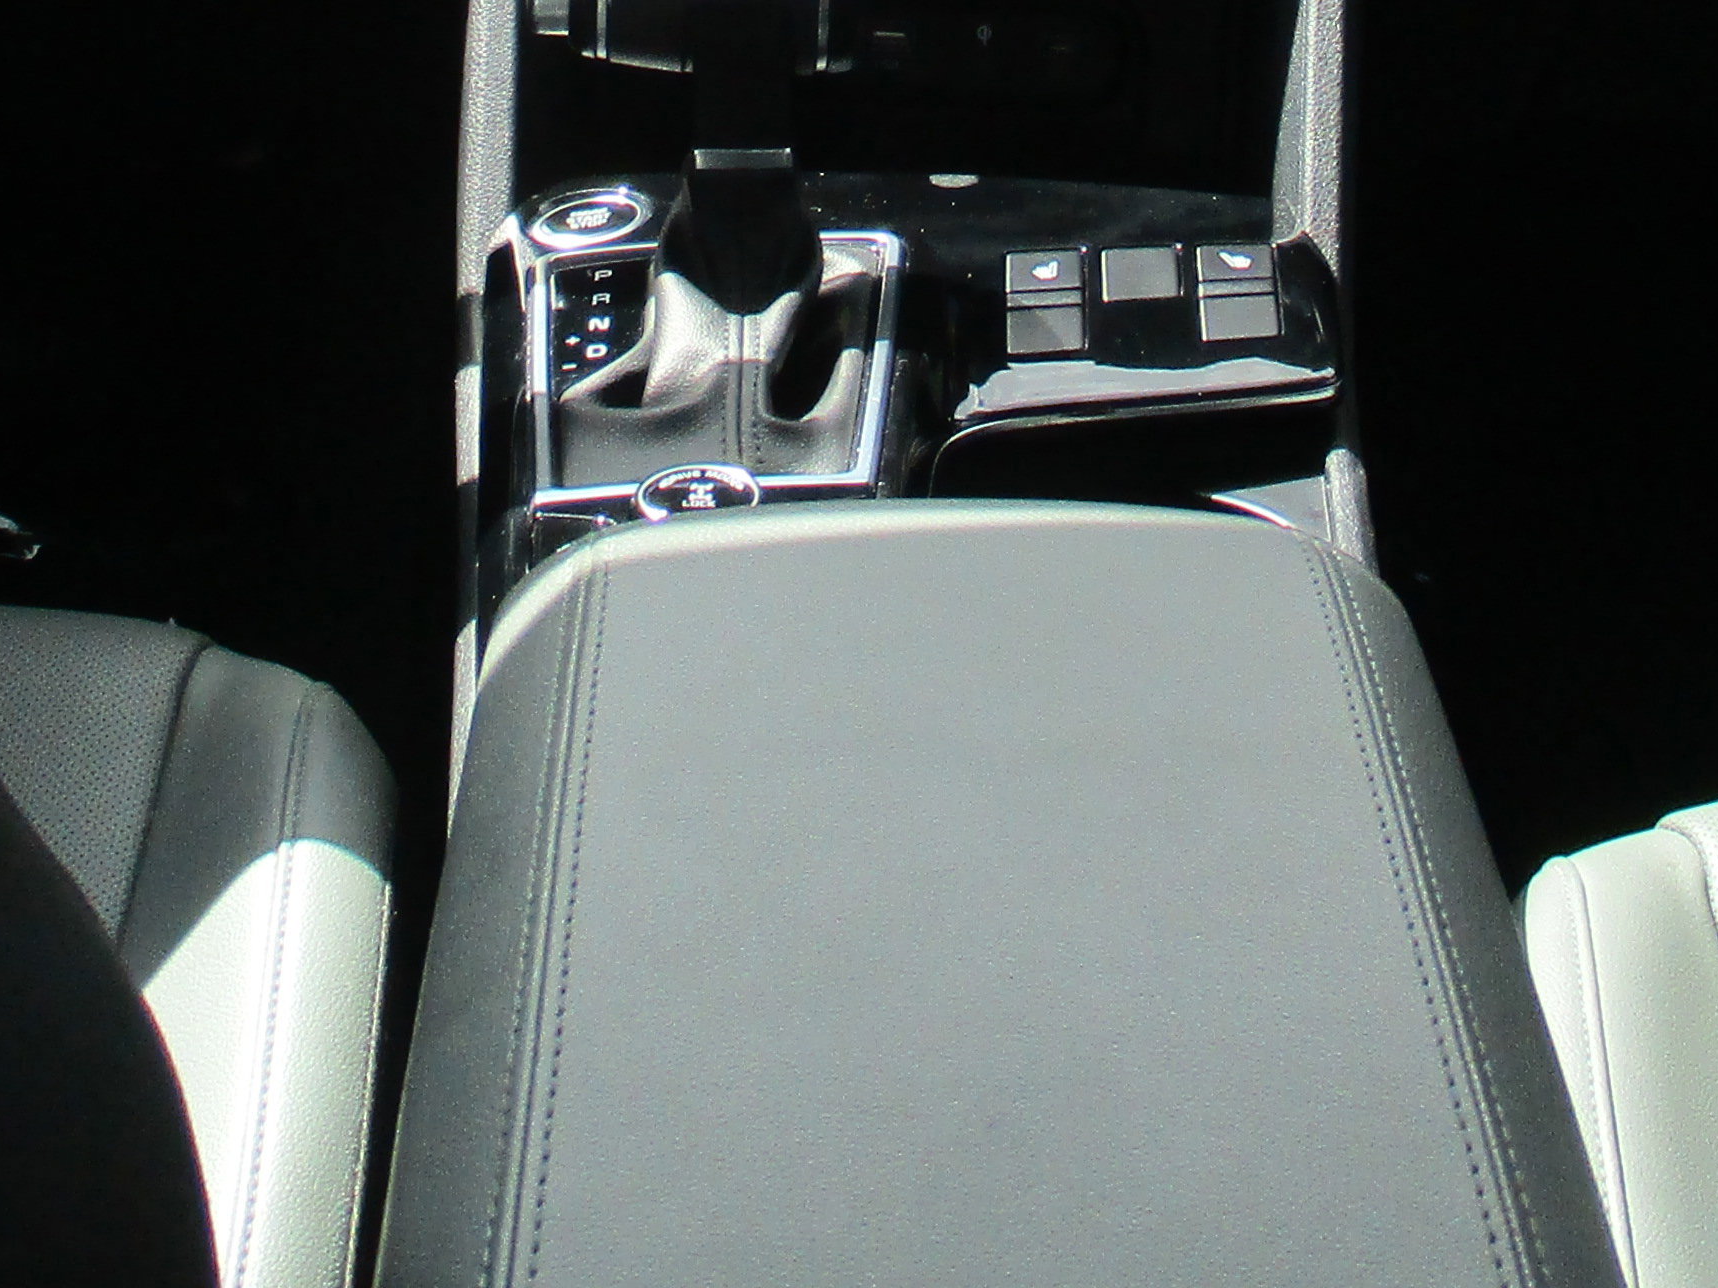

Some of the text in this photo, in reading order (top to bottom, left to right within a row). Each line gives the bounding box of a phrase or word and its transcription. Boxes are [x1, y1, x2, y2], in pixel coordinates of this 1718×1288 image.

[593, 269, 613, 282] P
[591, 292, 611, 306] R
[588, 316, 611, 332] N
[585, 343, 609, 360] D
